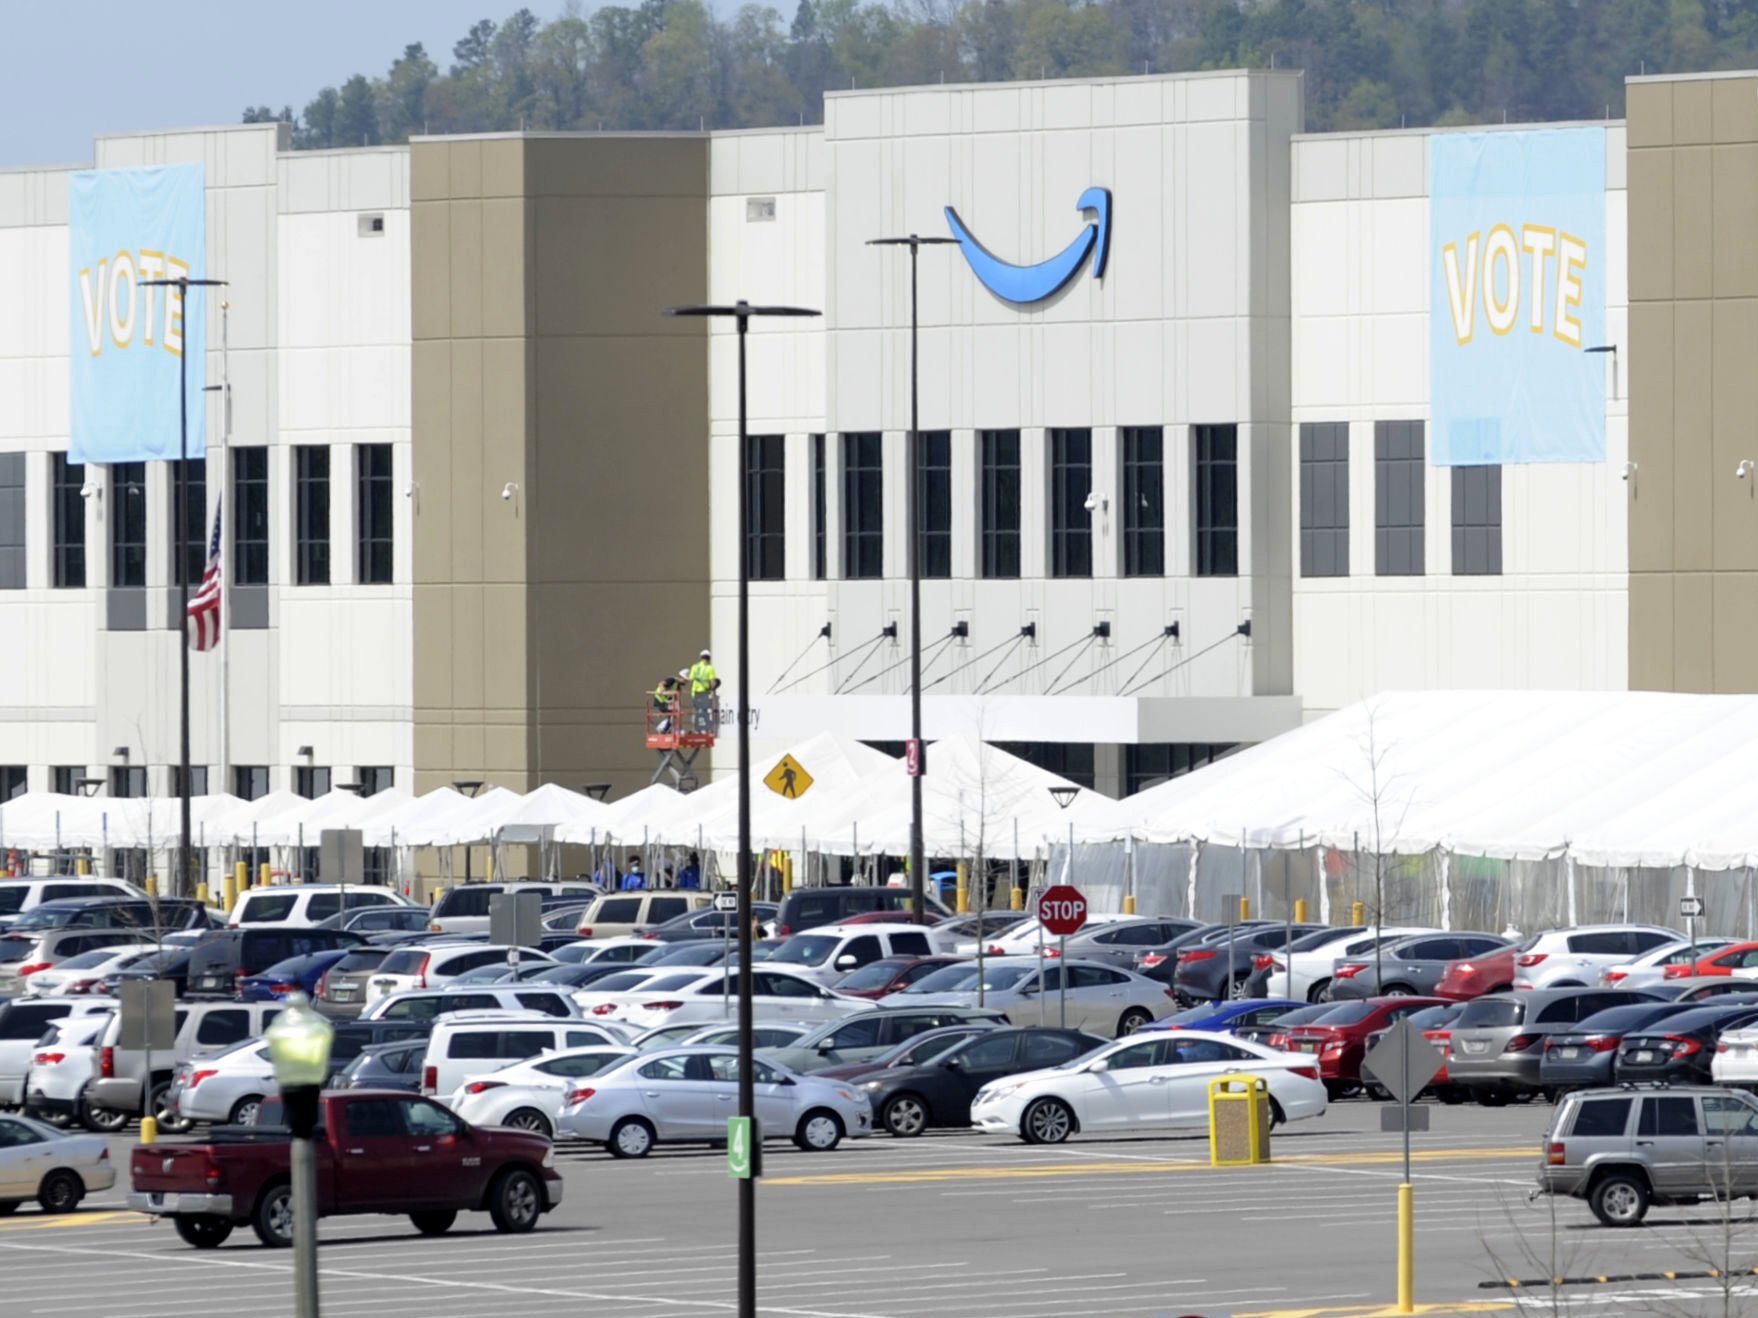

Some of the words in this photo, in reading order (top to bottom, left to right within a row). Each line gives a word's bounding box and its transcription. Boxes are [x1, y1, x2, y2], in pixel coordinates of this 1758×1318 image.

[79, 249, 190, 358] VOTE
[1442, 223, 1587, 348] VOTE
[908, 741, 916, 765] 2
[1041, 900, 1085, 920] STOP
[733, 1122, 745, 1160] 4
